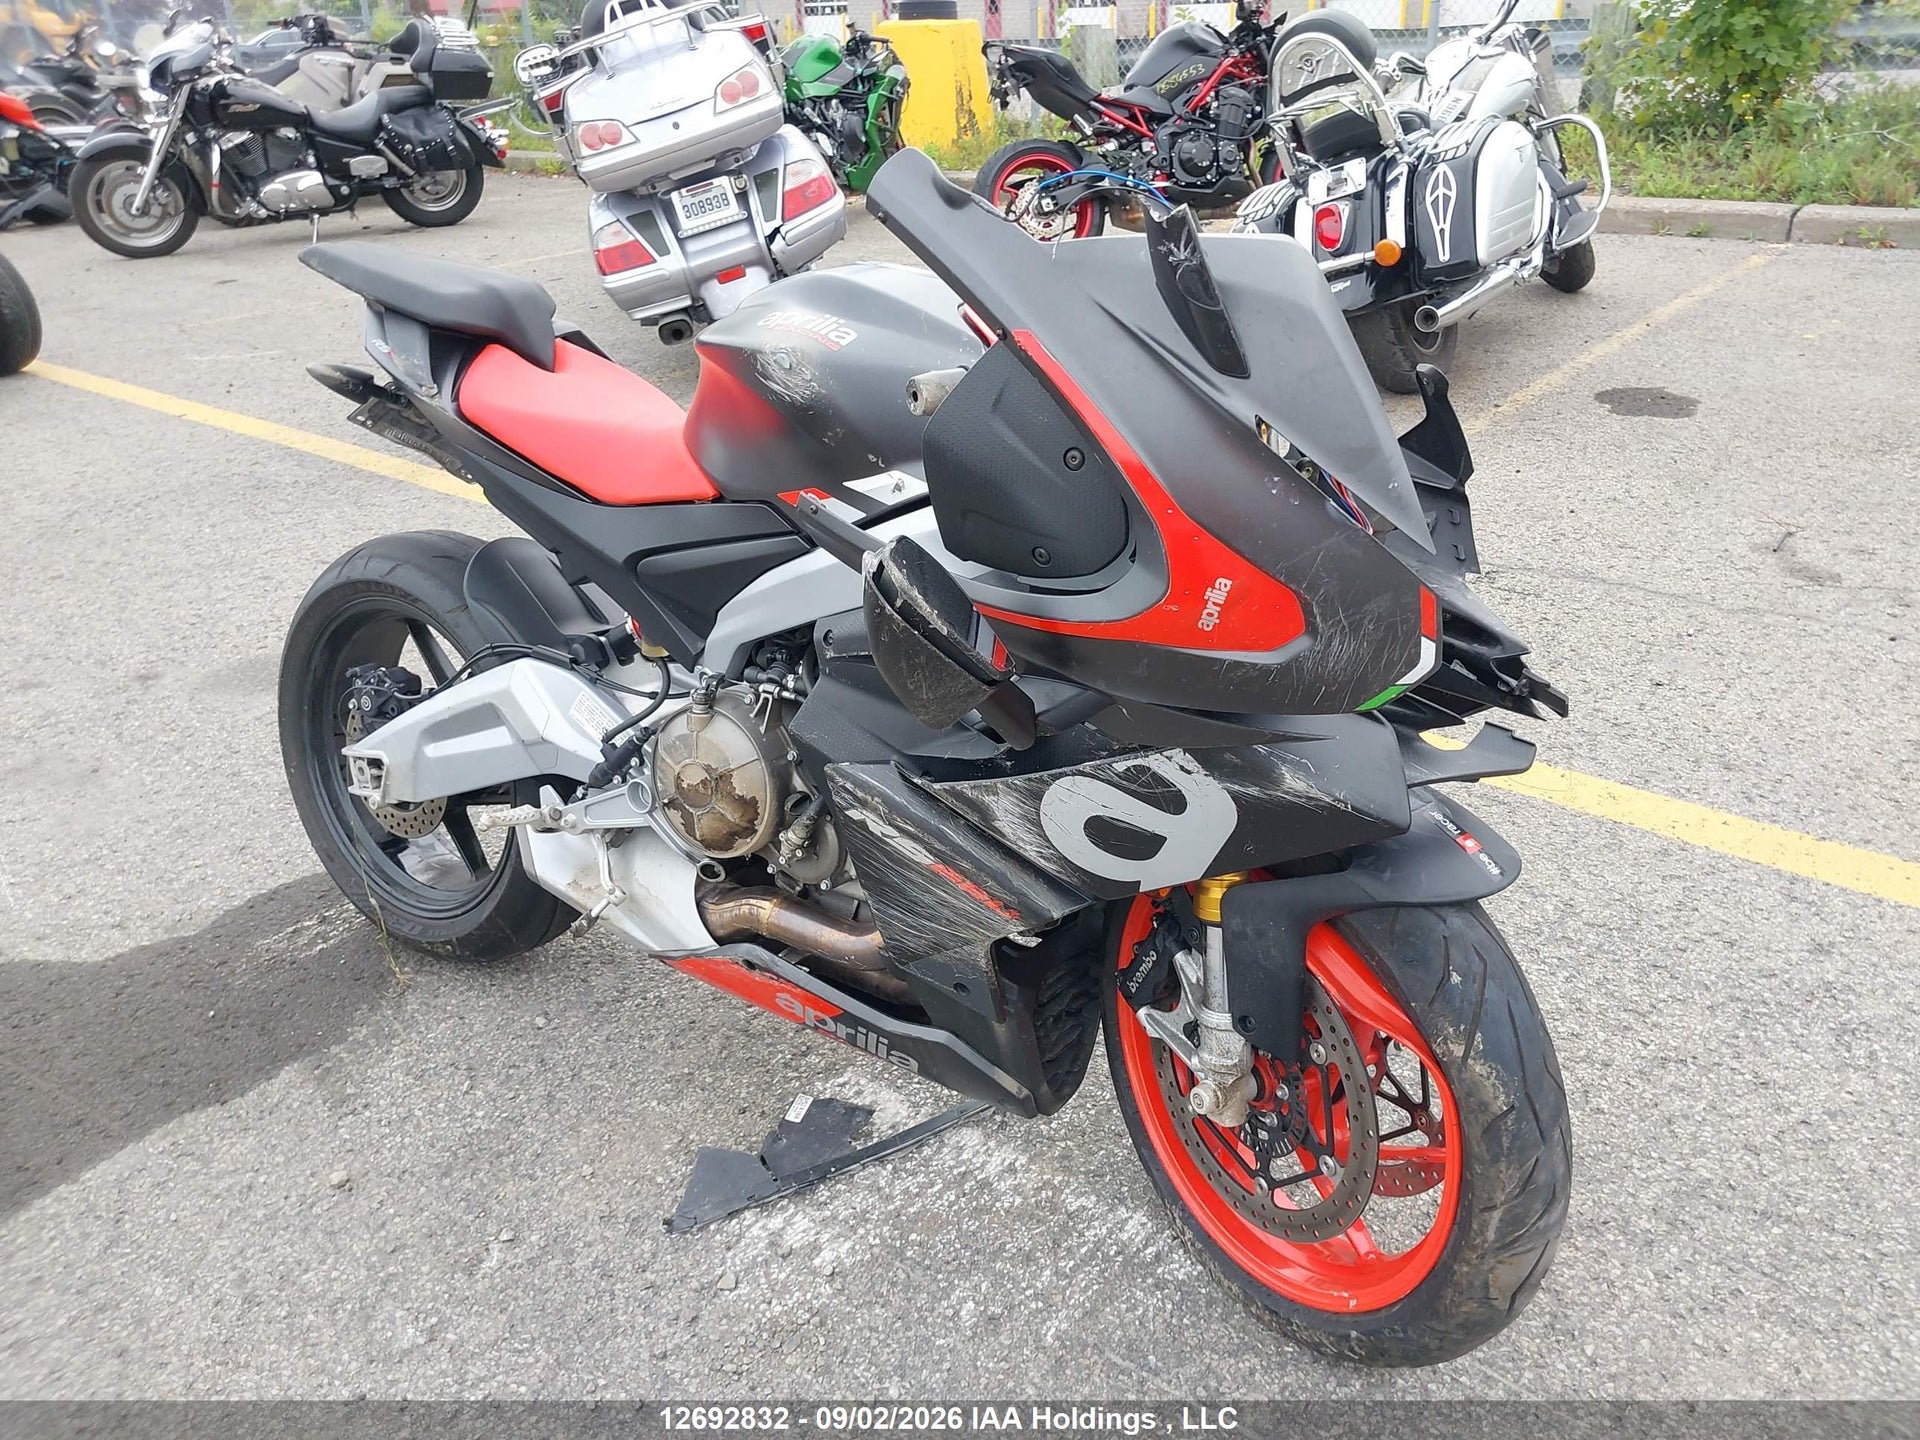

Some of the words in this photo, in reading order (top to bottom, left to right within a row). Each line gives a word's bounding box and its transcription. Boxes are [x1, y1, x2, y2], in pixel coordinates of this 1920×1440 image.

[757, 311, 858, 347] aprilia
[1197, 577, 1233, 631] aprilia
[1428, 810, 1462, 835] racer
[1126, 950, 1157, 994] brembo
[775, 992, 919, 1073] aprilia
